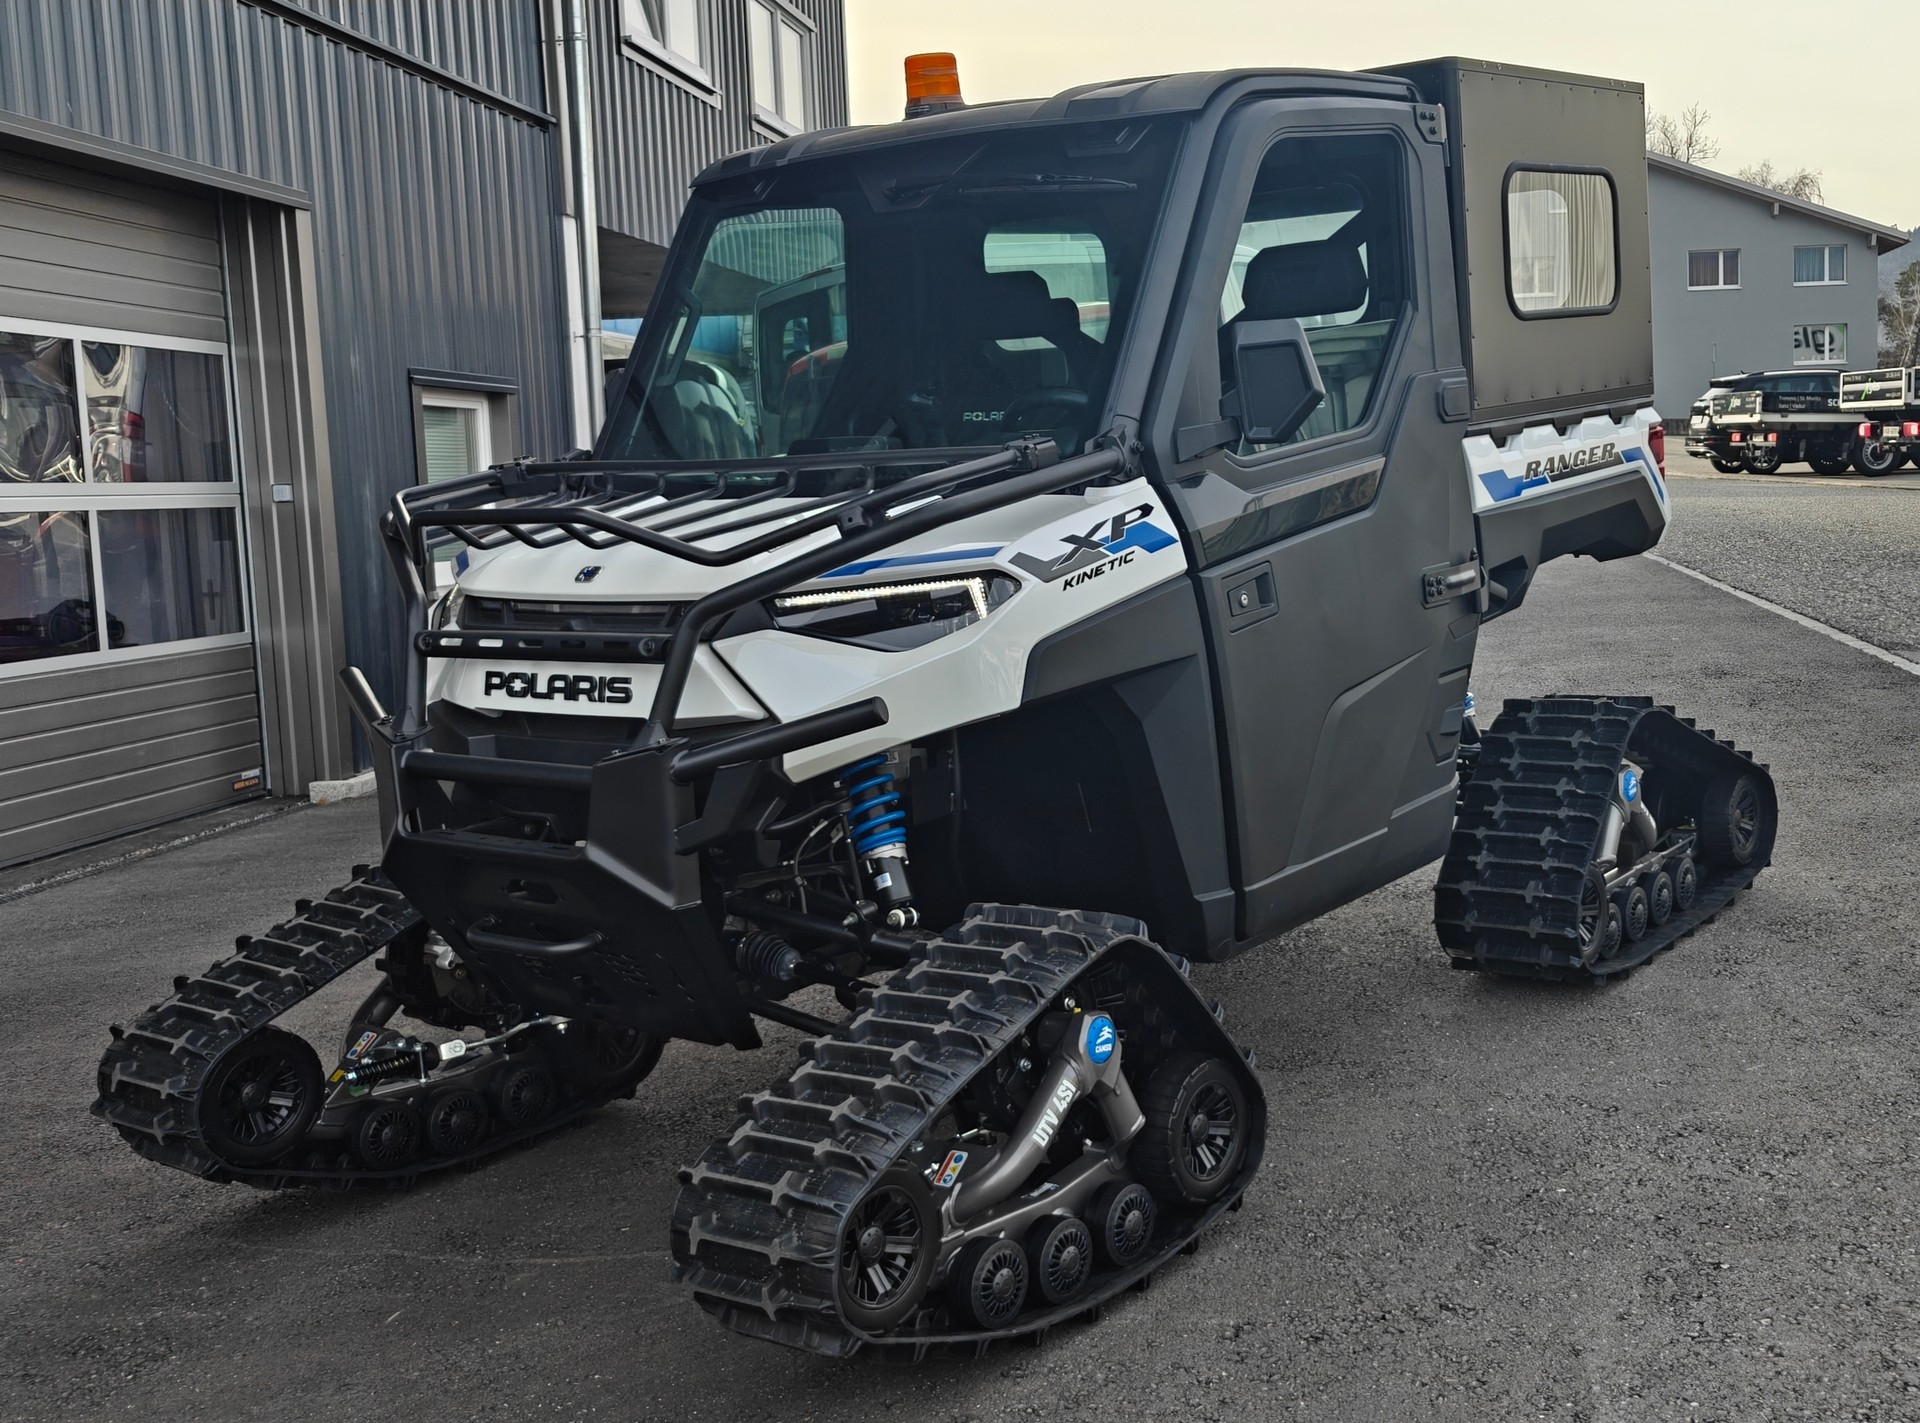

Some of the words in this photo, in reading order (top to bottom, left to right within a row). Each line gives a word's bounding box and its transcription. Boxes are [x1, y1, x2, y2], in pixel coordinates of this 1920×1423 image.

[1827, 398, 1841, 407] SC
[1524, 442, 1616, 481] RANGER
[1056, 502, 1154, 569] XP
[1062, 550, 1135, 591] KINETIC
[484, 670, 633, 704] POLARIS
[1032, 1108, 1059, 1147] UTV
